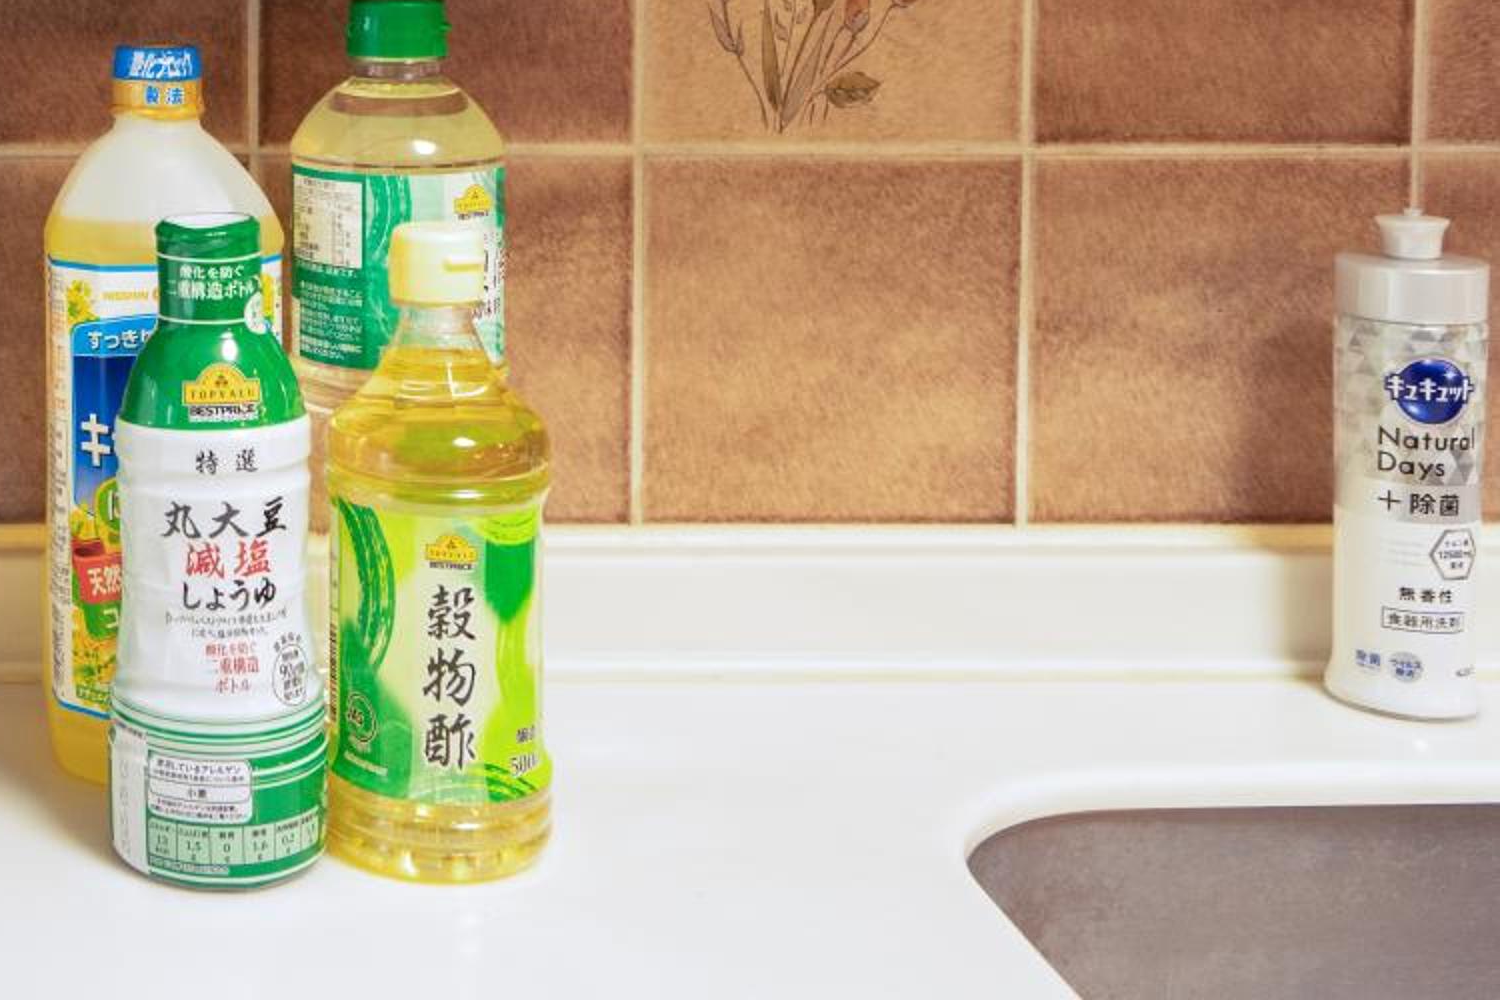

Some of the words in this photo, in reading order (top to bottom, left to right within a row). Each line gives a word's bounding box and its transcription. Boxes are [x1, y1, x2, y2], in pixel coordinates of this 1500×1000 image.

[1386, 375, 1473, 404] キュキュット
[81, 413, 117, 466] キ
[1378, 426, 1475, 451] Natural
[196, 448, 259, 475] 特選
[1378, 451, 1445, 480] Days
[161, 496, 286, 538] 丸大豆
[185, 539, 270, 578] 減塩
[183, 577, 276, 611] しょうゆ
[423, 585, 476, 770] 穀物酢
